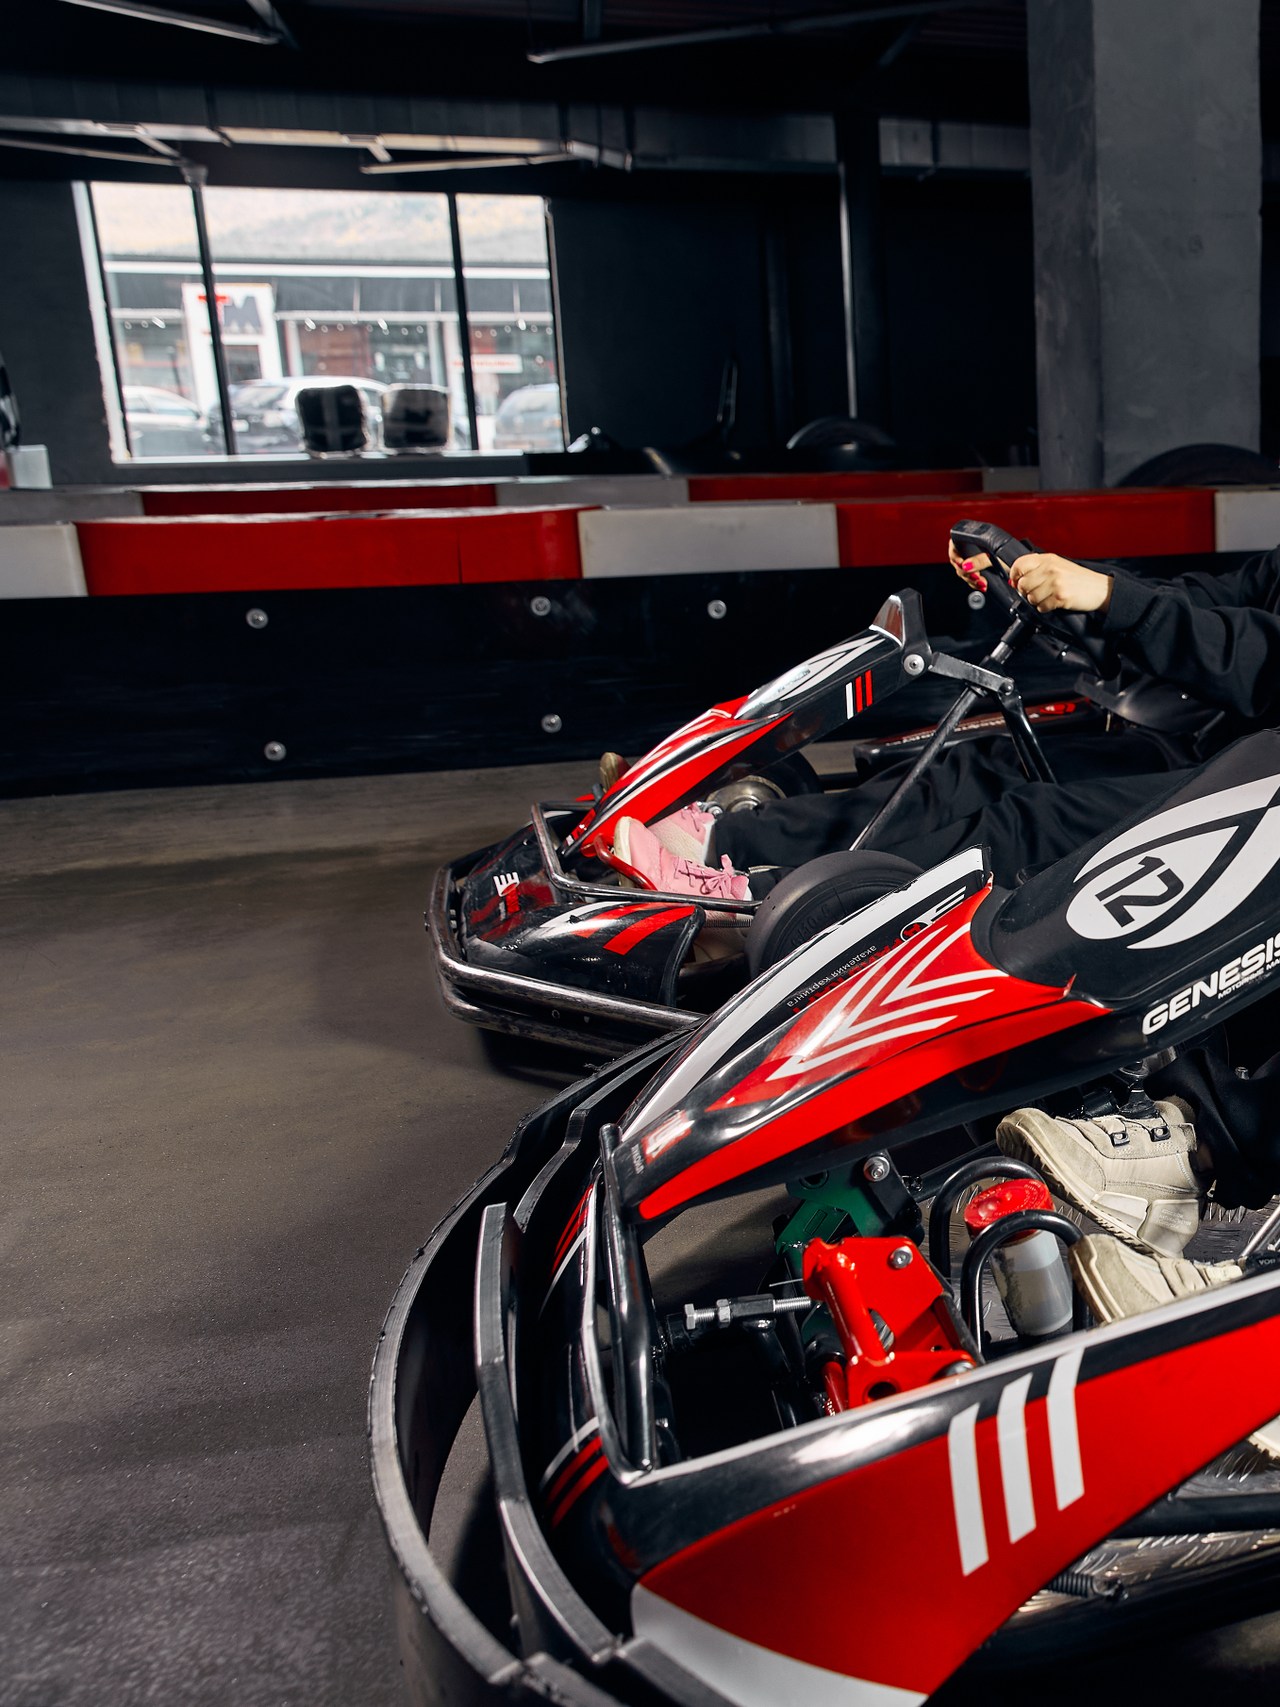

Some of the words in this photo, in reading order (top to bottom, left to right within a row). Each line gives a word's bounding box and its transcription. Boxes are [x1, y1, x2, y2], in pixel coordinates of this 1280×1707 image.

[1094, 855, 1185, 928] 12
[831, 945, 877, 979] академия
[786, 976, 831, 1007] картинга
